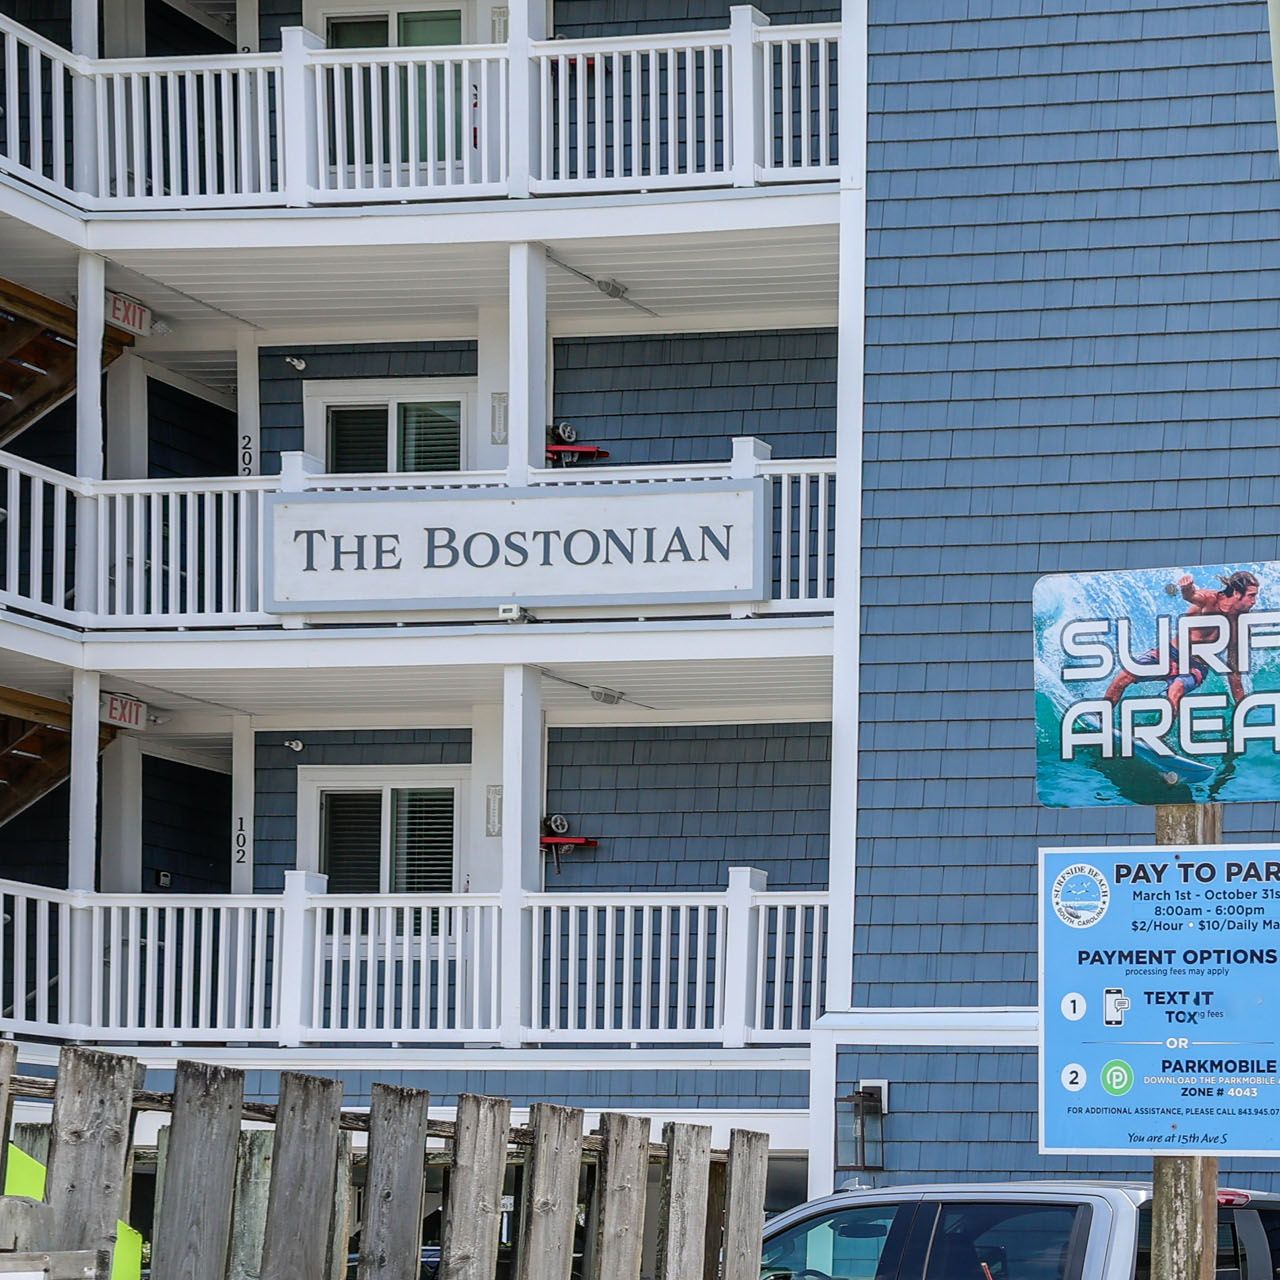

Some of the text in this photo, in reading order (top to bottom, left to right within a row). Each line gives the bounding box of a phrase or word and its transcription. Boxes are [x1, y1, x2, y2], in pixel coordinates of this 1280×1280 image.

[112, 296, 147, 331] EXIT
[293, 523, 735, 573] THE BOSTONIAN
[108, 696, 143, 726] EXIT
[235, 816, 247, 864] 102
[1114, 862, 1169, 884] PAY
[1177, 862, 1217, 884] TO
[1053, 865, 1109, 899] SURFSIDE BEACH
[1132, 890, 1171, 901] March
[1175, 890, 1192, 901] 1st
[1204, 889, 1258, 900] October
[1056, 906, 1105, 927] SOUTH CAROLINA
[1154, 905, 1203, 917] 8:00am
[1215, 905, 1265, 918] 6:00pm
[1131, 920, 1184, 932] $2/Hour
[1198, 919, 1259, 932] $10/Daily
[1077, 948, 1279, 965] PAYMENT OPTIONS
[1125, 966, 1230, 977] processing fees may apply
[1143, 991, 1190, 1005] TEXT
[1069, 999, 1077, 1014] 1
[1207, 1010, 1224, 1019] fees
[1165, 1037, 1189, 1049] OR
[1161, 1059, 1278, 1074] PARKMOBILE
[1068, 1070, 1080, 1085] 2
[1143, 1076, 1198, 1085] DOWNLOAD
[1199, 1076, 1217, 1085] THE
[1218, 1076, 1276, 1085] PARKMOBILE
[1180, 1087, 1258, 1097] ZONE # 4043
[1066, 1106, 1084, 1115] FOR
[1084, 1106, 1132, 1115] ADDITIONAL
[1134, 1107, 1184, 1117] ASSISTANCE,
[1185, 1107, 1214, 1116] PLEASE
[1216, 1107, 1237, 1116] CALL
[1127, 1132, 1228, 1145] You are at 15th Ave S
